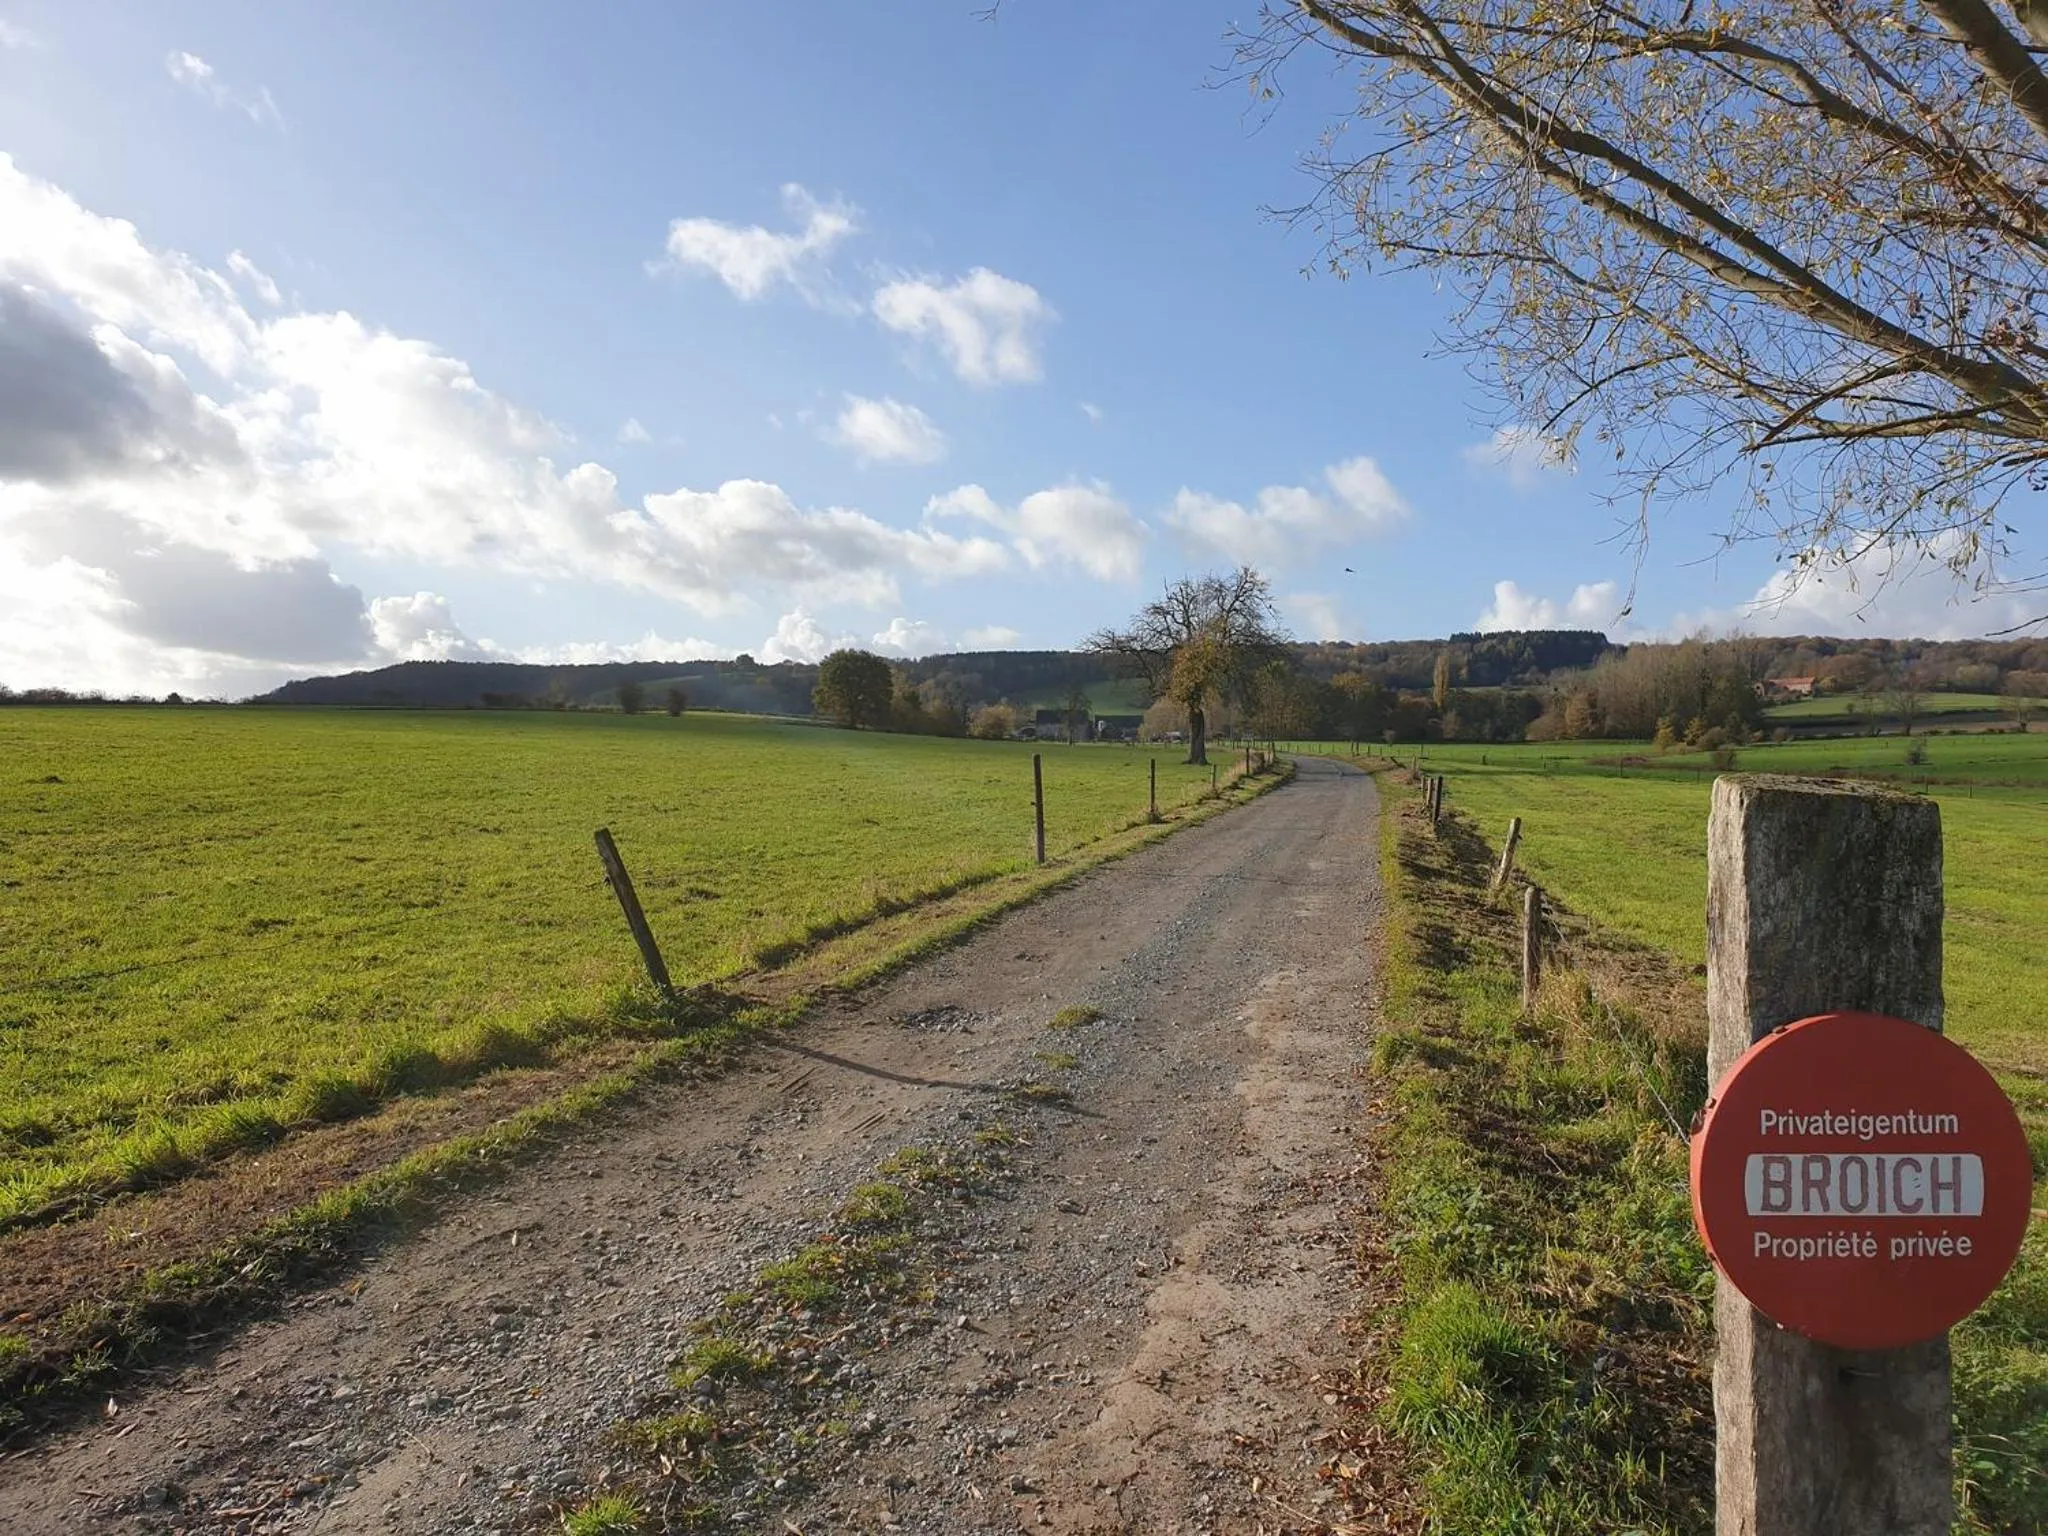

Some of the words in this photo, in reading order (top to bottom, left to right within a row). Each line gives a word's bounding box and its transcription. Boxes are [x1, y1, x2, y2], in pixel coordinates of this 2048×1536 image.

[1760, 1109, 1958, 1140] Privateigentum
[1760, 1155, 1961, 1214] BROICH
[1754, 1231, 1878, 1260] Propriété
[1890, 1230, 1973, 1260] privée
